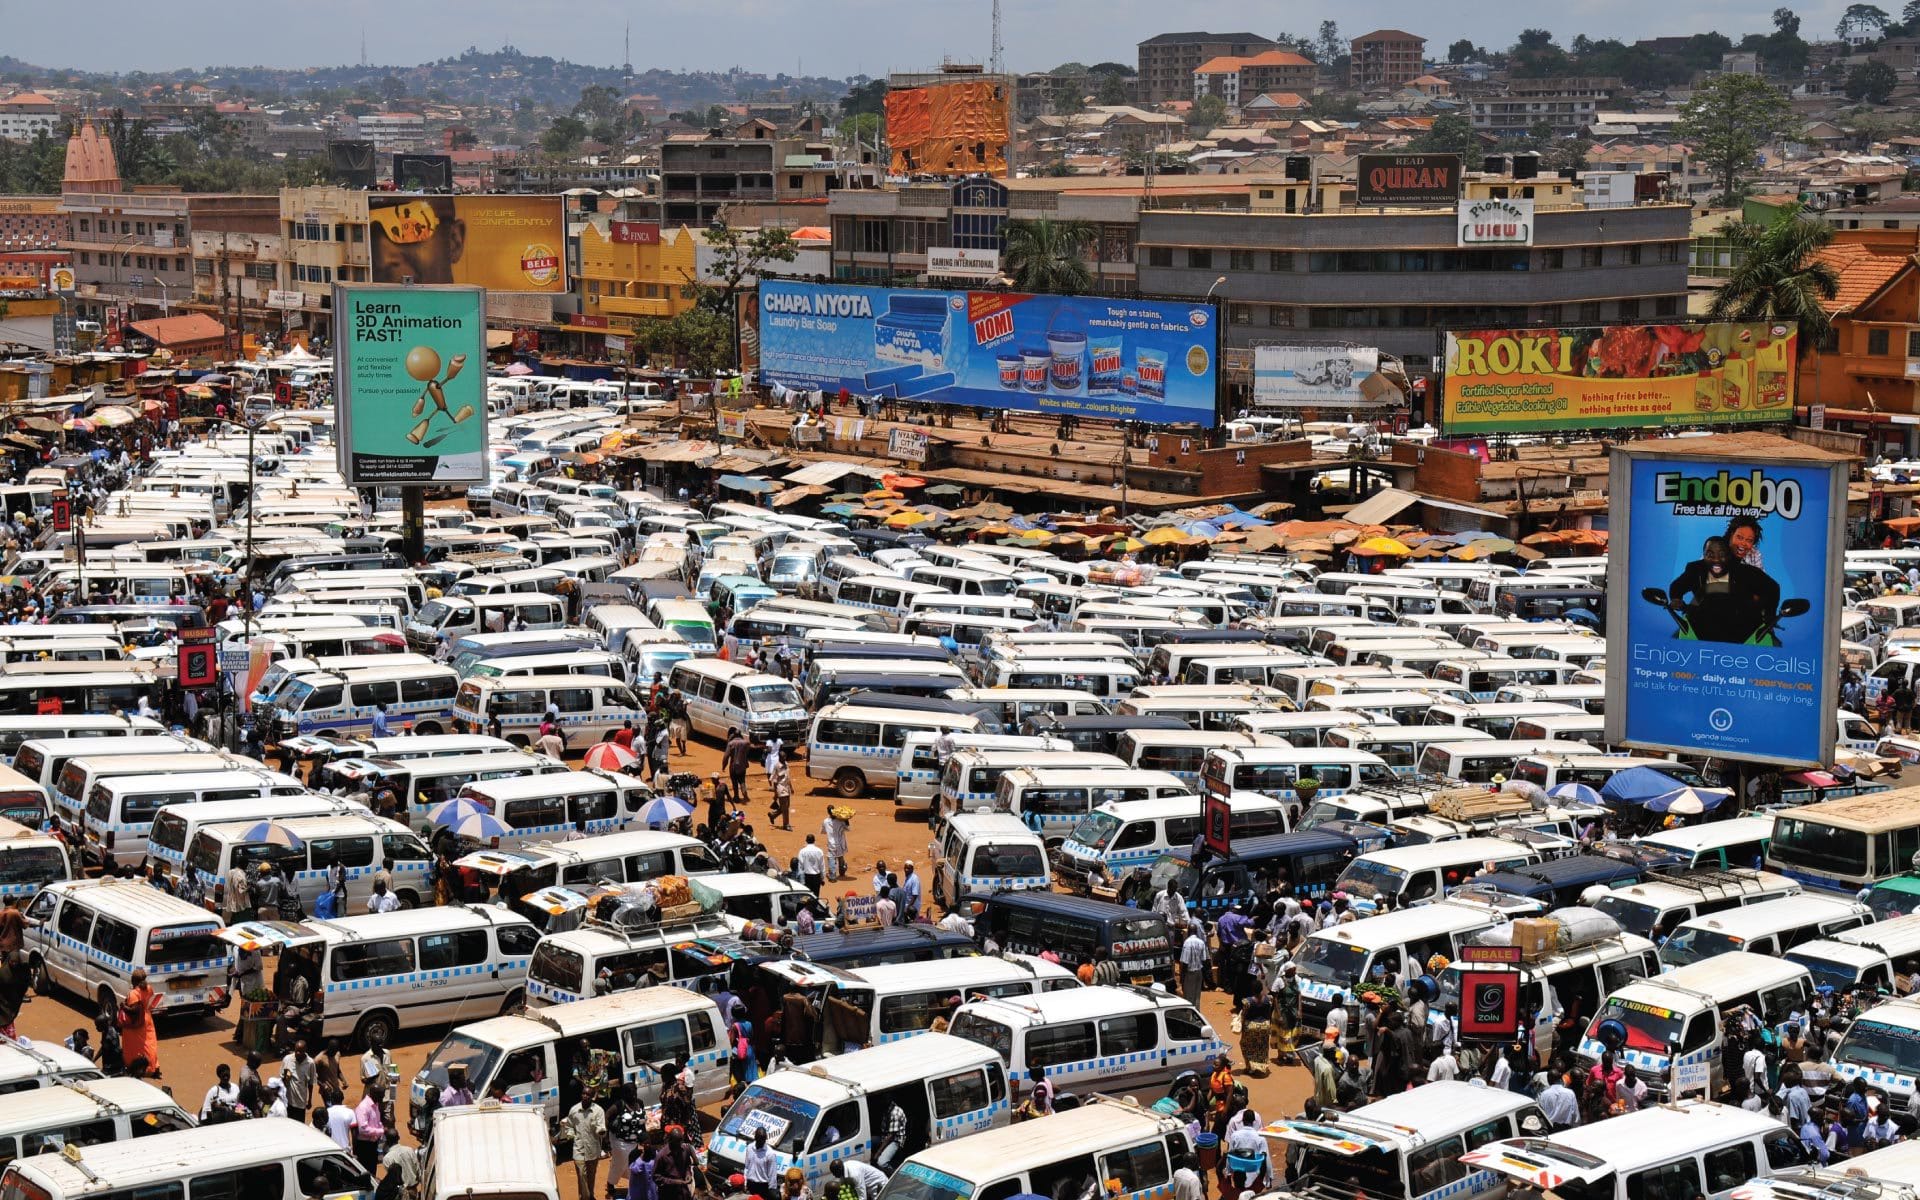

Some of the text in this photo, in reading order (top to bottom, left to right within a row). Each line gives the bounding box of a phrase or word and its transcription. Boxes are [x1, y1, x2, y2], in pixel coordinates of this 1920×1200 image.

[1396, 157, 1424, 166] READ
[1370, 167, 1448, 193] QURAN
[1469, 201, 1522, 218] Pioneer
[472, 218, 553, 226] CONFIDENTLY
[630, 232, 650, 241] FINCA
[527, 259, 553, 269] BELL
[932, 258, 994, 269] GAMING INTERNATIONAL
[356, 301, 401, 313] Learn
[764, 293, 873, 318] CHAPA NYOTA
[1107, 308, 1127, 318] Tough
[1138, 310, 1162, 320] stains,
[356, 316, 462, 328] 3D Animation
[769, 315, 837, 333] Laundry Bar Soap
[975, 309, 1014, 345] NOMI
[1089, 319, 1126, 329] remarkably
[1127, 321, 1149, 330] gentle
[357, 329, 402, 342] FAST!
[896, 330, 916, 338] CHAPA
[892, 337, 921, 349] NYOTA
[986, 333, 1014, 350] SUPER FOAM
[775, 352, 807, 362] performance
[807, 355, 828, 364] cleaning
[828, 356, 838, 364] and
[839, 357, 850, 367] long
[1455, 336, 1574, 377] ROKI
[1053, 363, 1079, 376] NOMI
[1094, 357, 1120, 372] NOMI
[1001, 371, 1017, 381] NOMI
[1024, 368, 1045, 381] NOMI
[1138, 367, 1164, 382] NOMI
[1461, 383, 1553, 398] Fortified Super Refined
[1758, 383, 1780, 392] ROKI
[1582, 391, 1670, 403] Nothing fries better...
[1039, 399, 1060, 407] Whites
[1110, 404, 1137, 414] Brighter
[1456, 398, 1568, 415] Edible Vegetable Cooking Oil
[1580, 402, 1672, 415] nothing tastes as good
[1664, 415, 1677, 423] Also
[1678, 415, 1704, 423] available
[1712, 414, 1729, 422] packs
[1730, 413, 1737, 421] of
[1752, 412, 1763, 420] and
[1675, 503, 1696, 515] Free
[1697, 504, 1712, 515] talk
[1714, 504, 1725, 515] all
[1726, 505, 1741, 516] the
[1633, 644, 1816, 675] Enjoy Free Calls!
[1634, 668, 1668, 680] Top-up
[1702, 674, 1727, 685] daily,
[1728, 675, 1746, 685] dial
[1633, 680, 1649, 690] and
[1651, 681, 1666, 691] talk
[1668, 683, 1680, 691] for
[1682, 684, 1699, 694] free
[1701, 685, 1724, 696] (UTL
[1726, 689, 1736, 697] to
[1738, 689, 1761, 701] UTL)
[1764, 692, 1773, 701] all
[1776, 694, 1791, 706] day
[1691, 733, 1750, 744] uganda telecom
[847, 898, 875, 908] TORORO
[1471, 950, 1513, 959] MBALE
[1478, 1013, 1500, 1022] zain
[1679, 1066, 1699, 1075] MBALE
[751, 1112, 786, 1128] MUTUNGO
